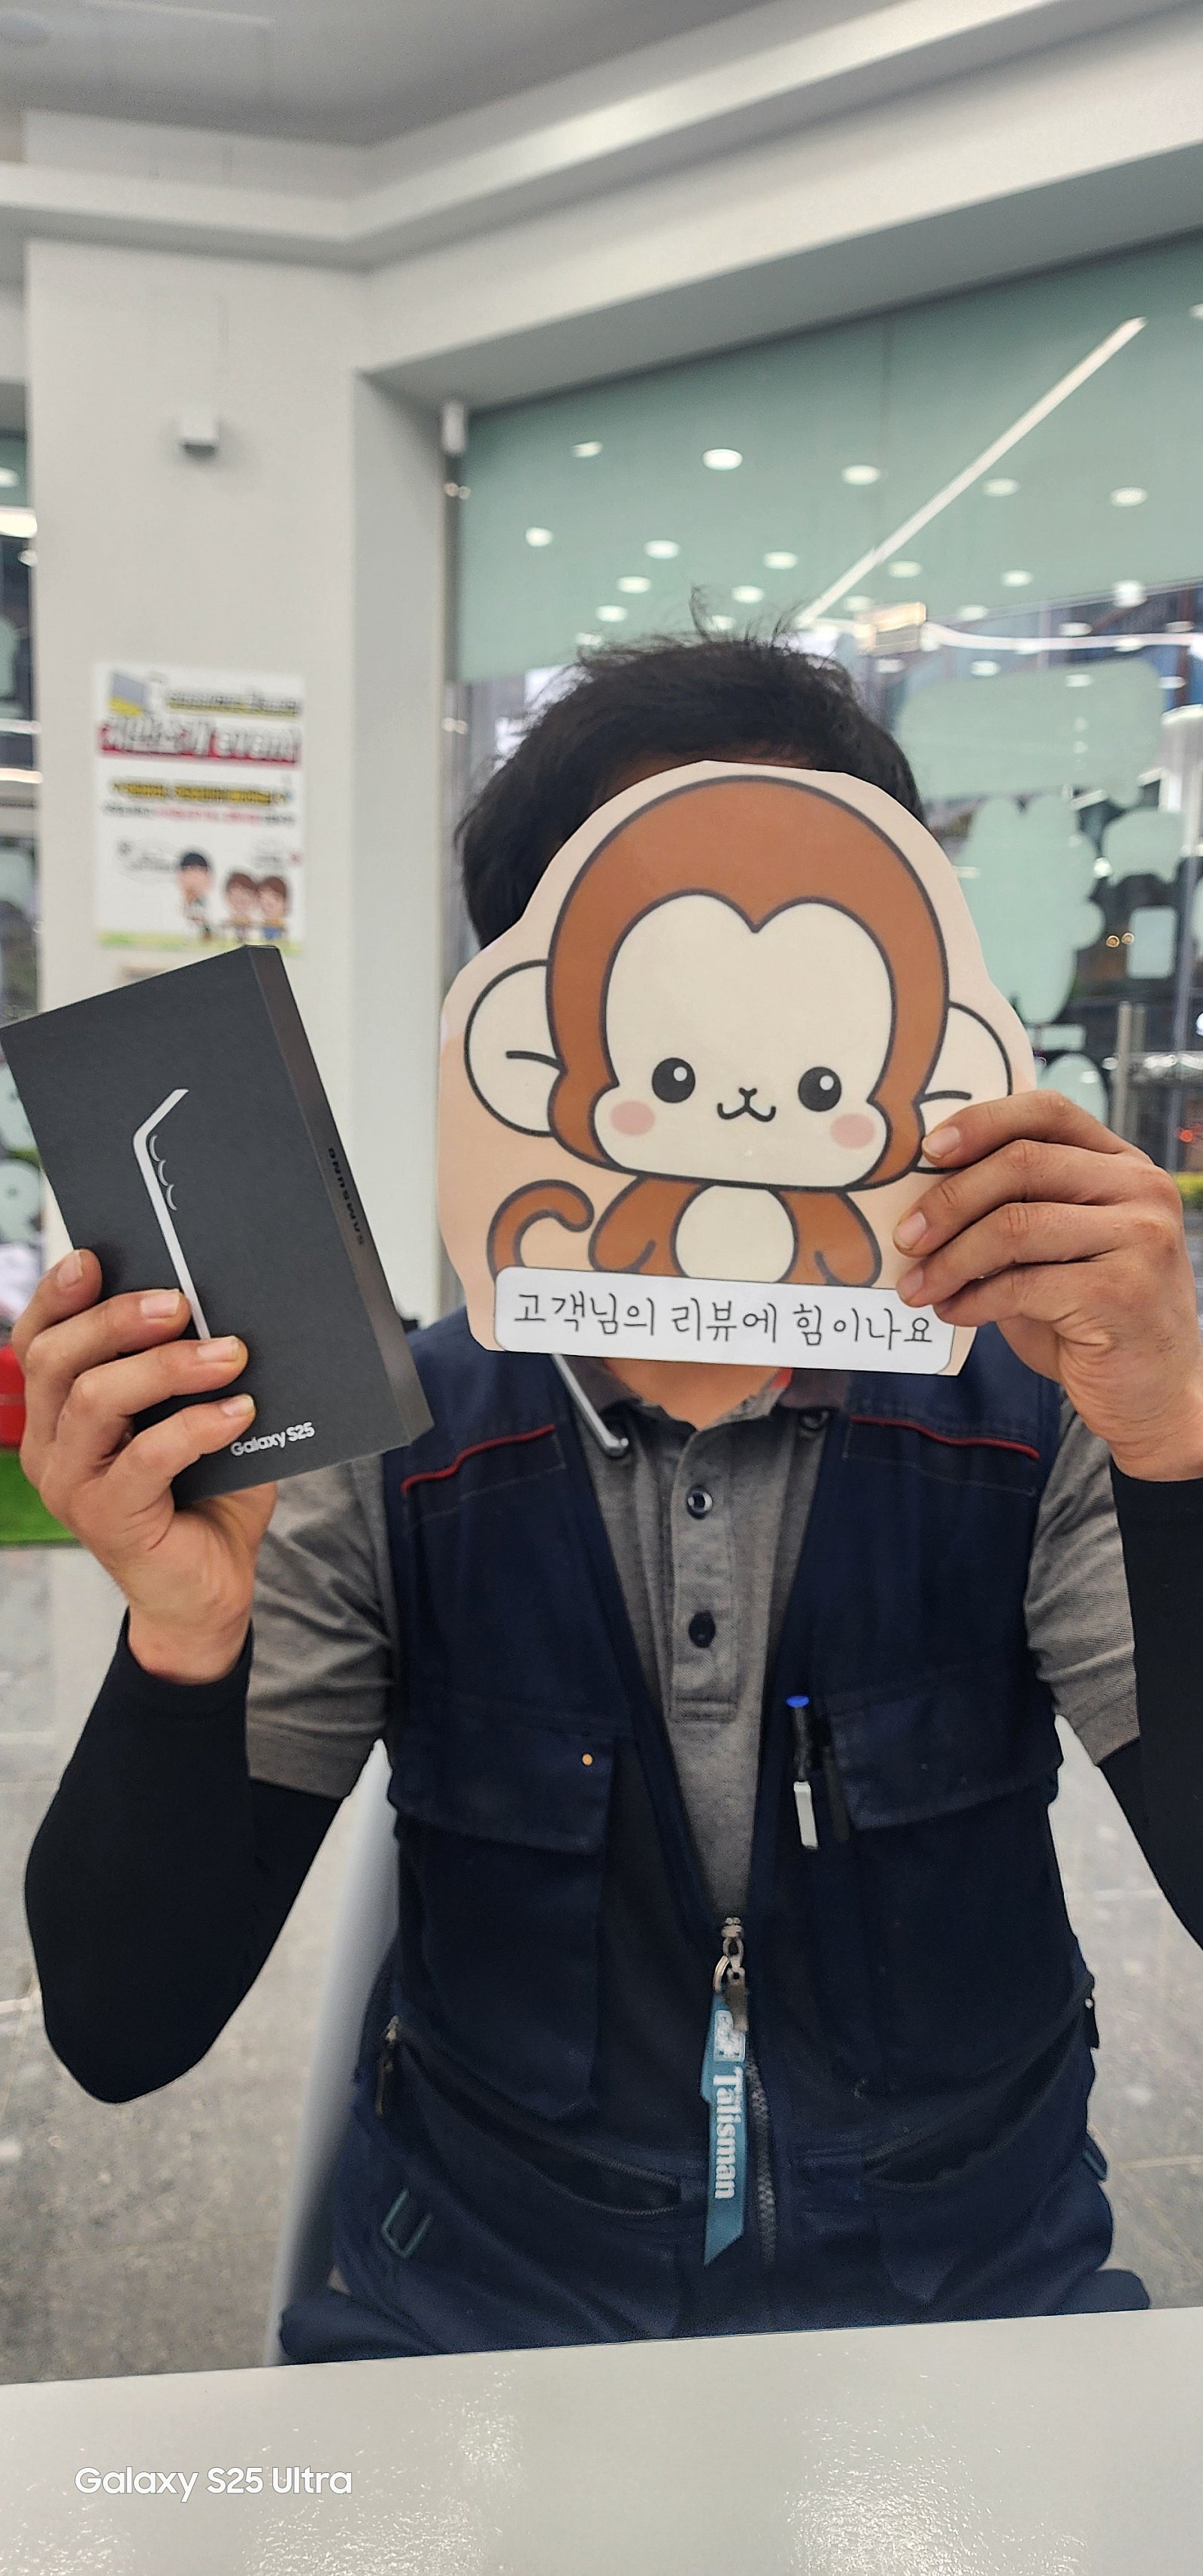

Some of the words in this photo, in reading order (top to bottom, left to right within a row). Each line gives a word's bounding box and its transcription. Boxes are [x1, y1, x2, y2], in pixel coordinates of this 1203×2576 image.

[328, 1147, 363, 1245] SAMSUNG
[514, 1290, 655, 1335] 고객님의
[671, 1298, 777, 1342] 리뷰에
[230, 1432, 286, 1456] Galaxy
[286, 1422, 315, 1442] S25
[712, 2065, 743, 2200] Talisman
